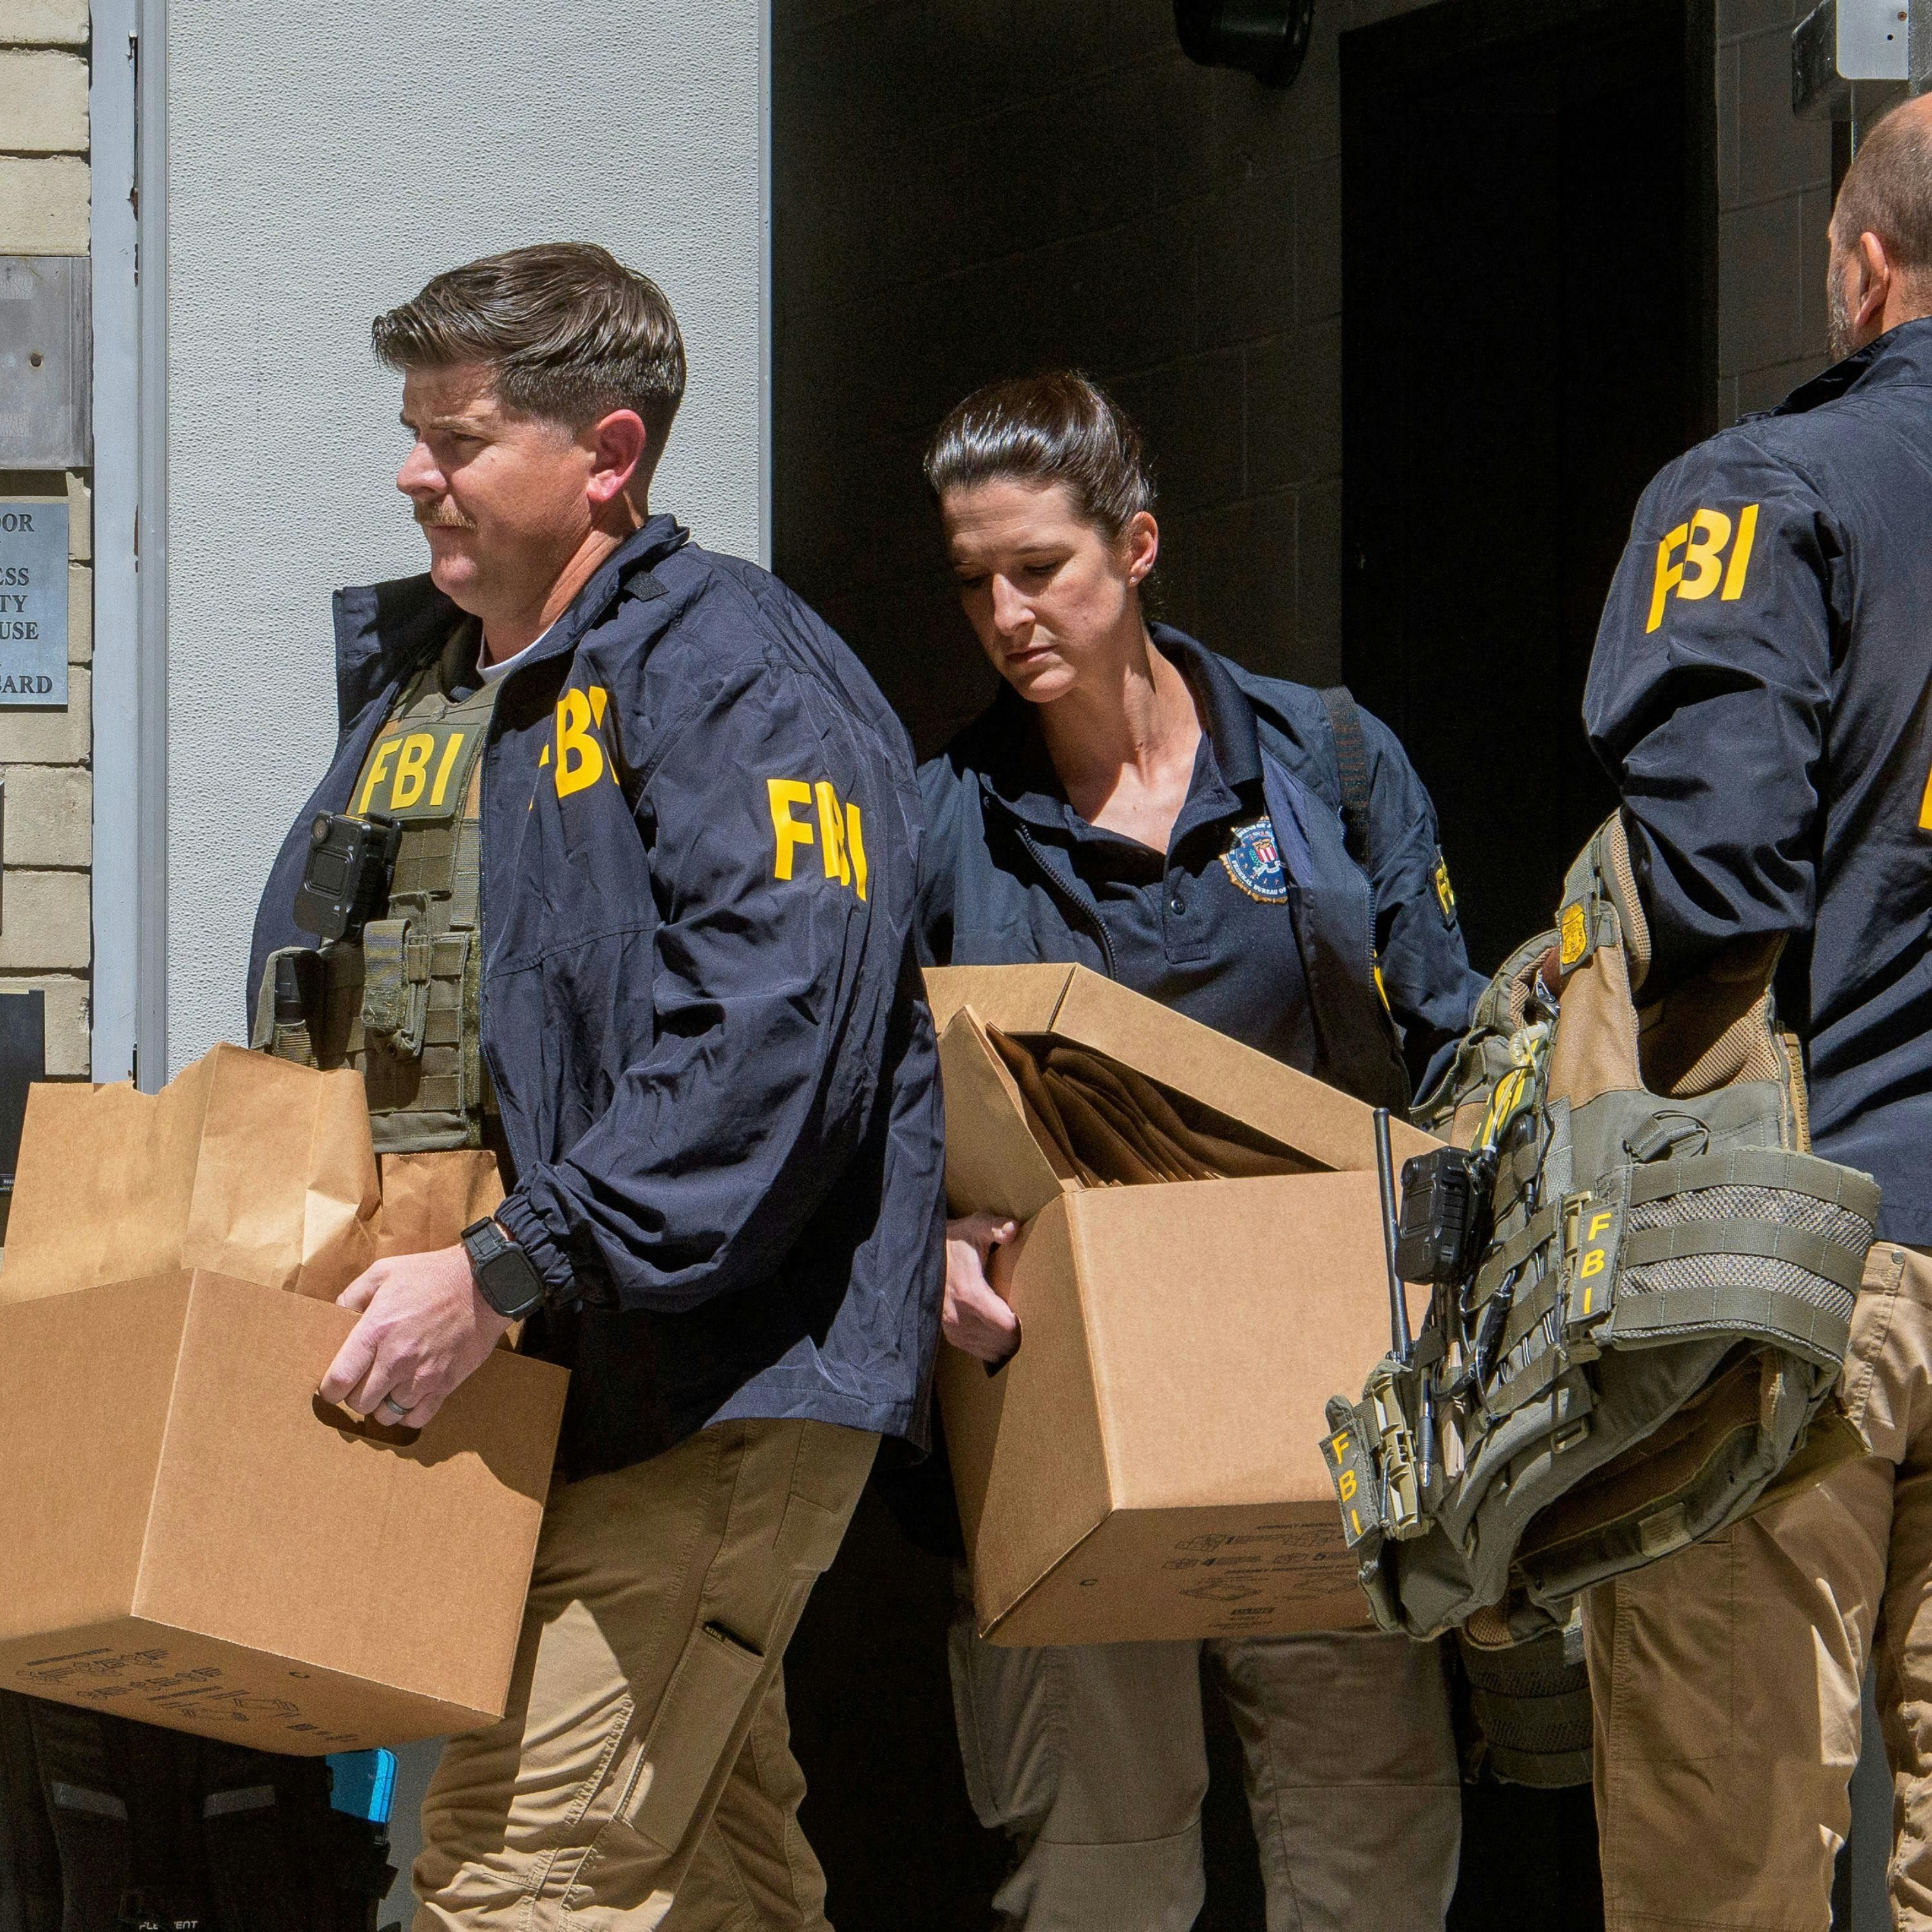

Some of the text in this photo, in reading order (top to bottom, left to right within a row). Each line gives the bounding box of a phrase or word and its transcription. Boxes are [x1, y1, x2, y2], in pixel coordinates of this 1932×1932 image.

[0, 513, 35, 533] OR
[0, 567, 29, 587] SS
[1646, 504, 1759, 634] FBI
[0, 676, 53, 694] ARD
[358, 734, 464, 815] FBI
[767, 779, 867, 902] FBI
[1581, 1213, 1611, 1314] FBI
[1332, 1432, 1362, 1536] FBI
